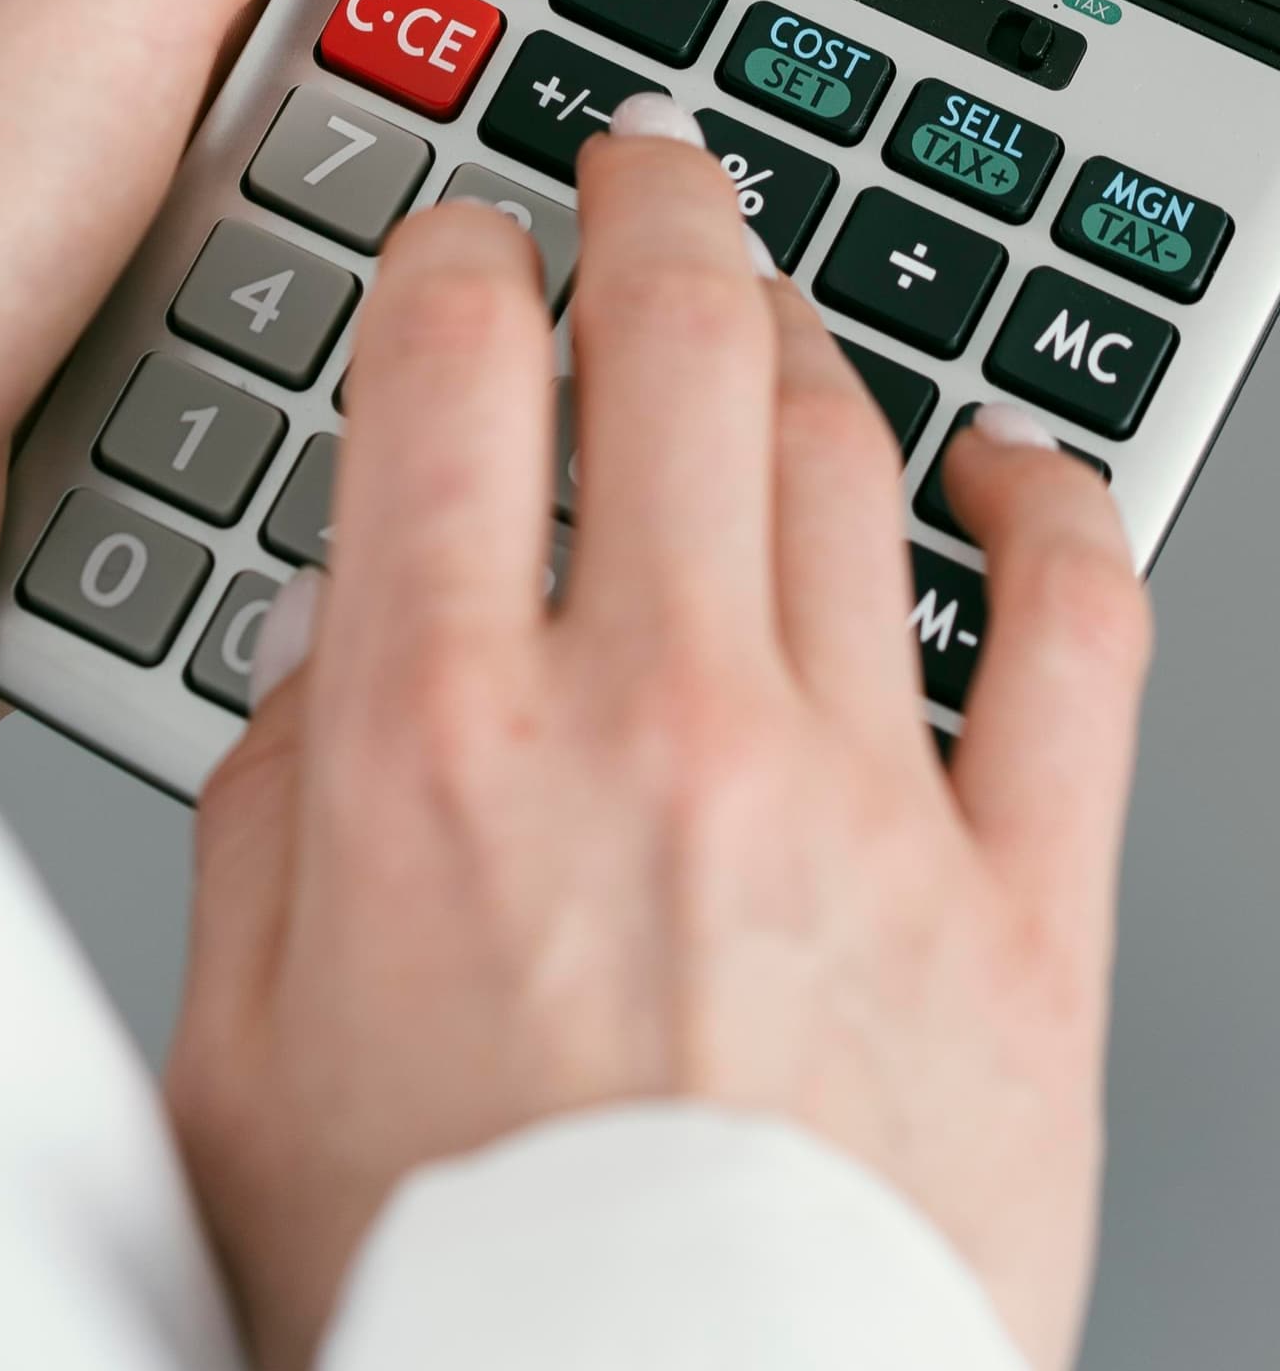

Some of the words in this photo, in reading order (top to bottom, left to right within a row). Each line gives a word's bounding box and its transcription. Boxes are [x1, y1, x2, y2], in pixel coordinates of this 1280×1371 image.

[769, 15, 872, 80] COST
[762, 57, 836, 109] SET
[301, 114, 379, 187] 7
[922, 126, 1010, 188] TAX+
[938, 94, 1024, 159] SELL
[1101, 170, 1196, 233] MGN
[1097, 206, 1178, 265] TAX-
[228, 268, 296, 334] 4
[1033, 308, 1134, 385] MC
[170, 404, 220, 472] 1
[78, 533, 149, 609] 0
